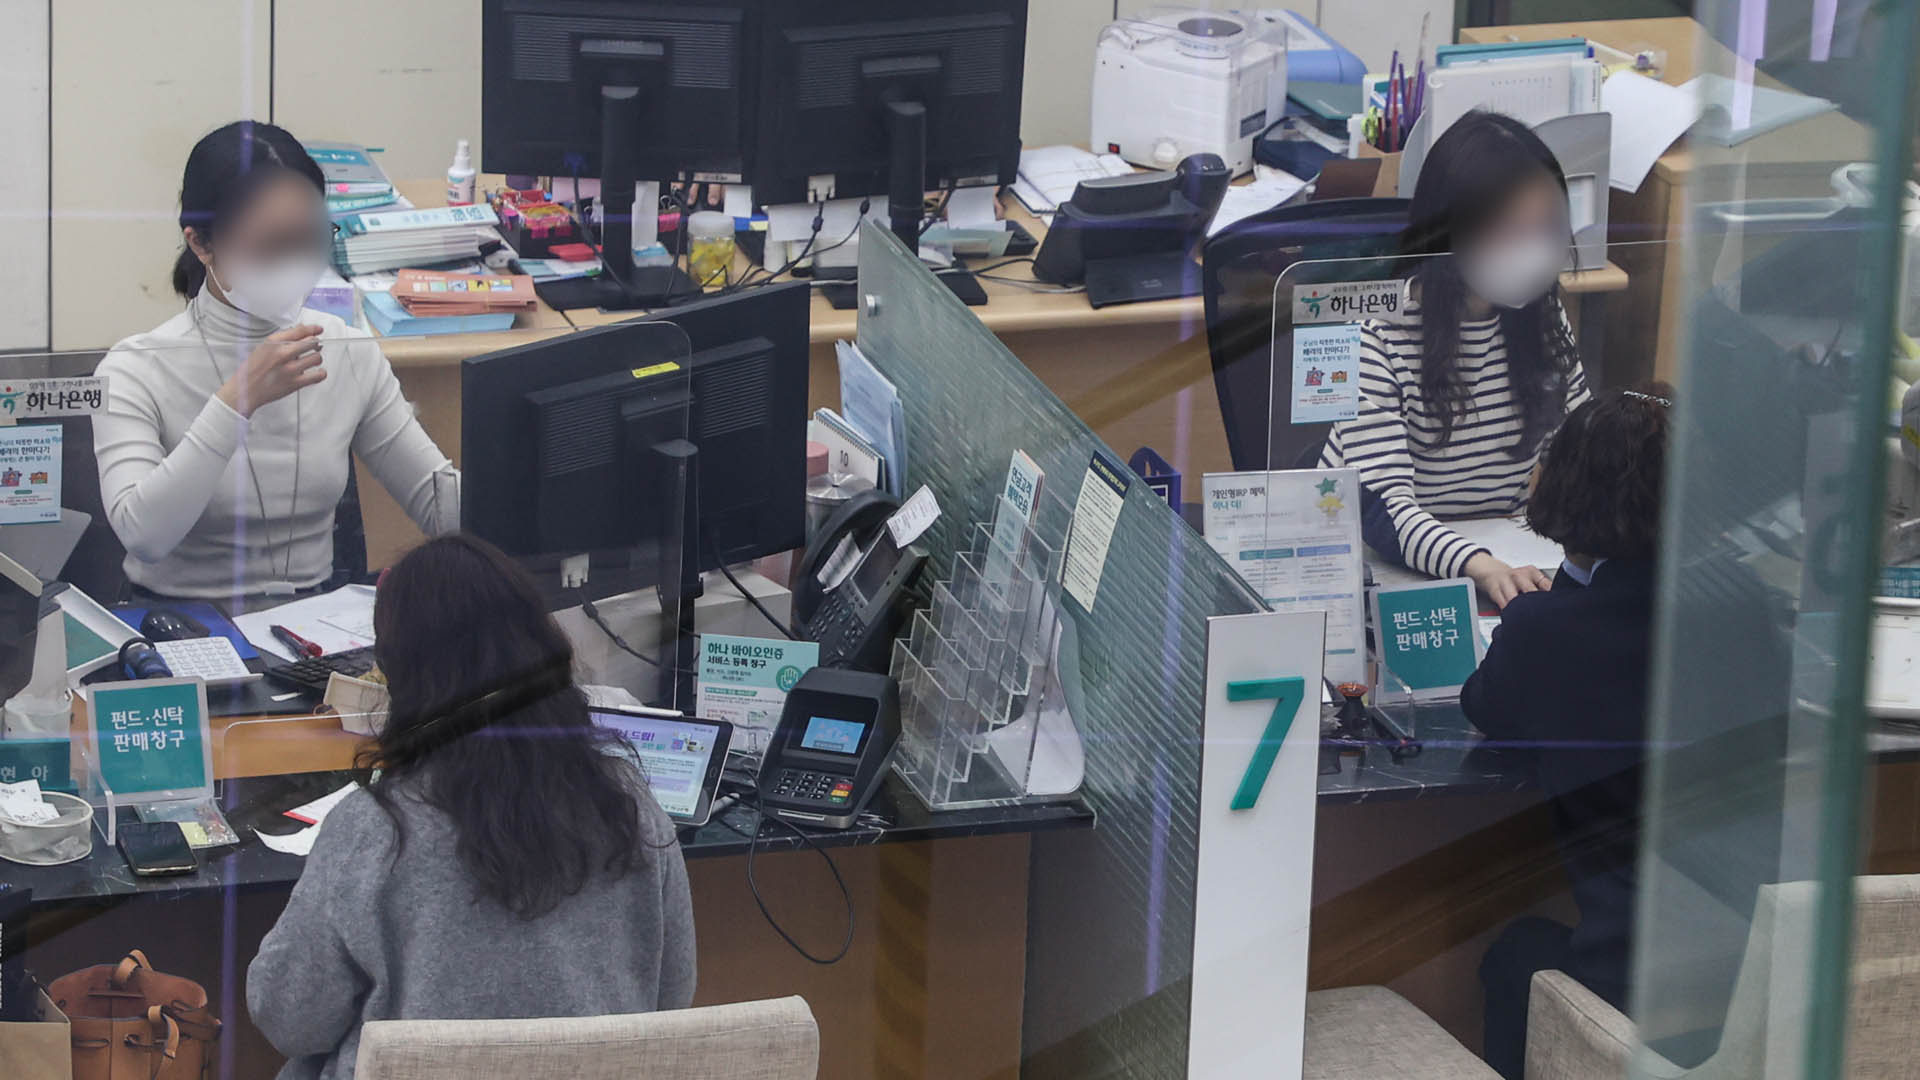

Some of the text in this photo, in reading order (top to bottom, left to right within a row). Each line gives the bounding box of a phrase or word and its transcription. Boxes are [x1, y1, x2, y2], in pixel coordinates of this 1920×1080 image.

[1330, 293, 1398, 315] 하나은행
[26, 389, 101, 411] 하나은행
[1393, 606, 1457, 630] 펀드·신탁
[708, 642, 785, 660] 하나 바이오인증
[1396, 629, 1460, 652] 판매창구
[707, 655, 767, 669] 서비스 등록 창구
[111, 705, 184, 730] 펀드·신탁
[113, 729, 185, 753] 판매창구
[1226, 676, 1305, 811] 7
